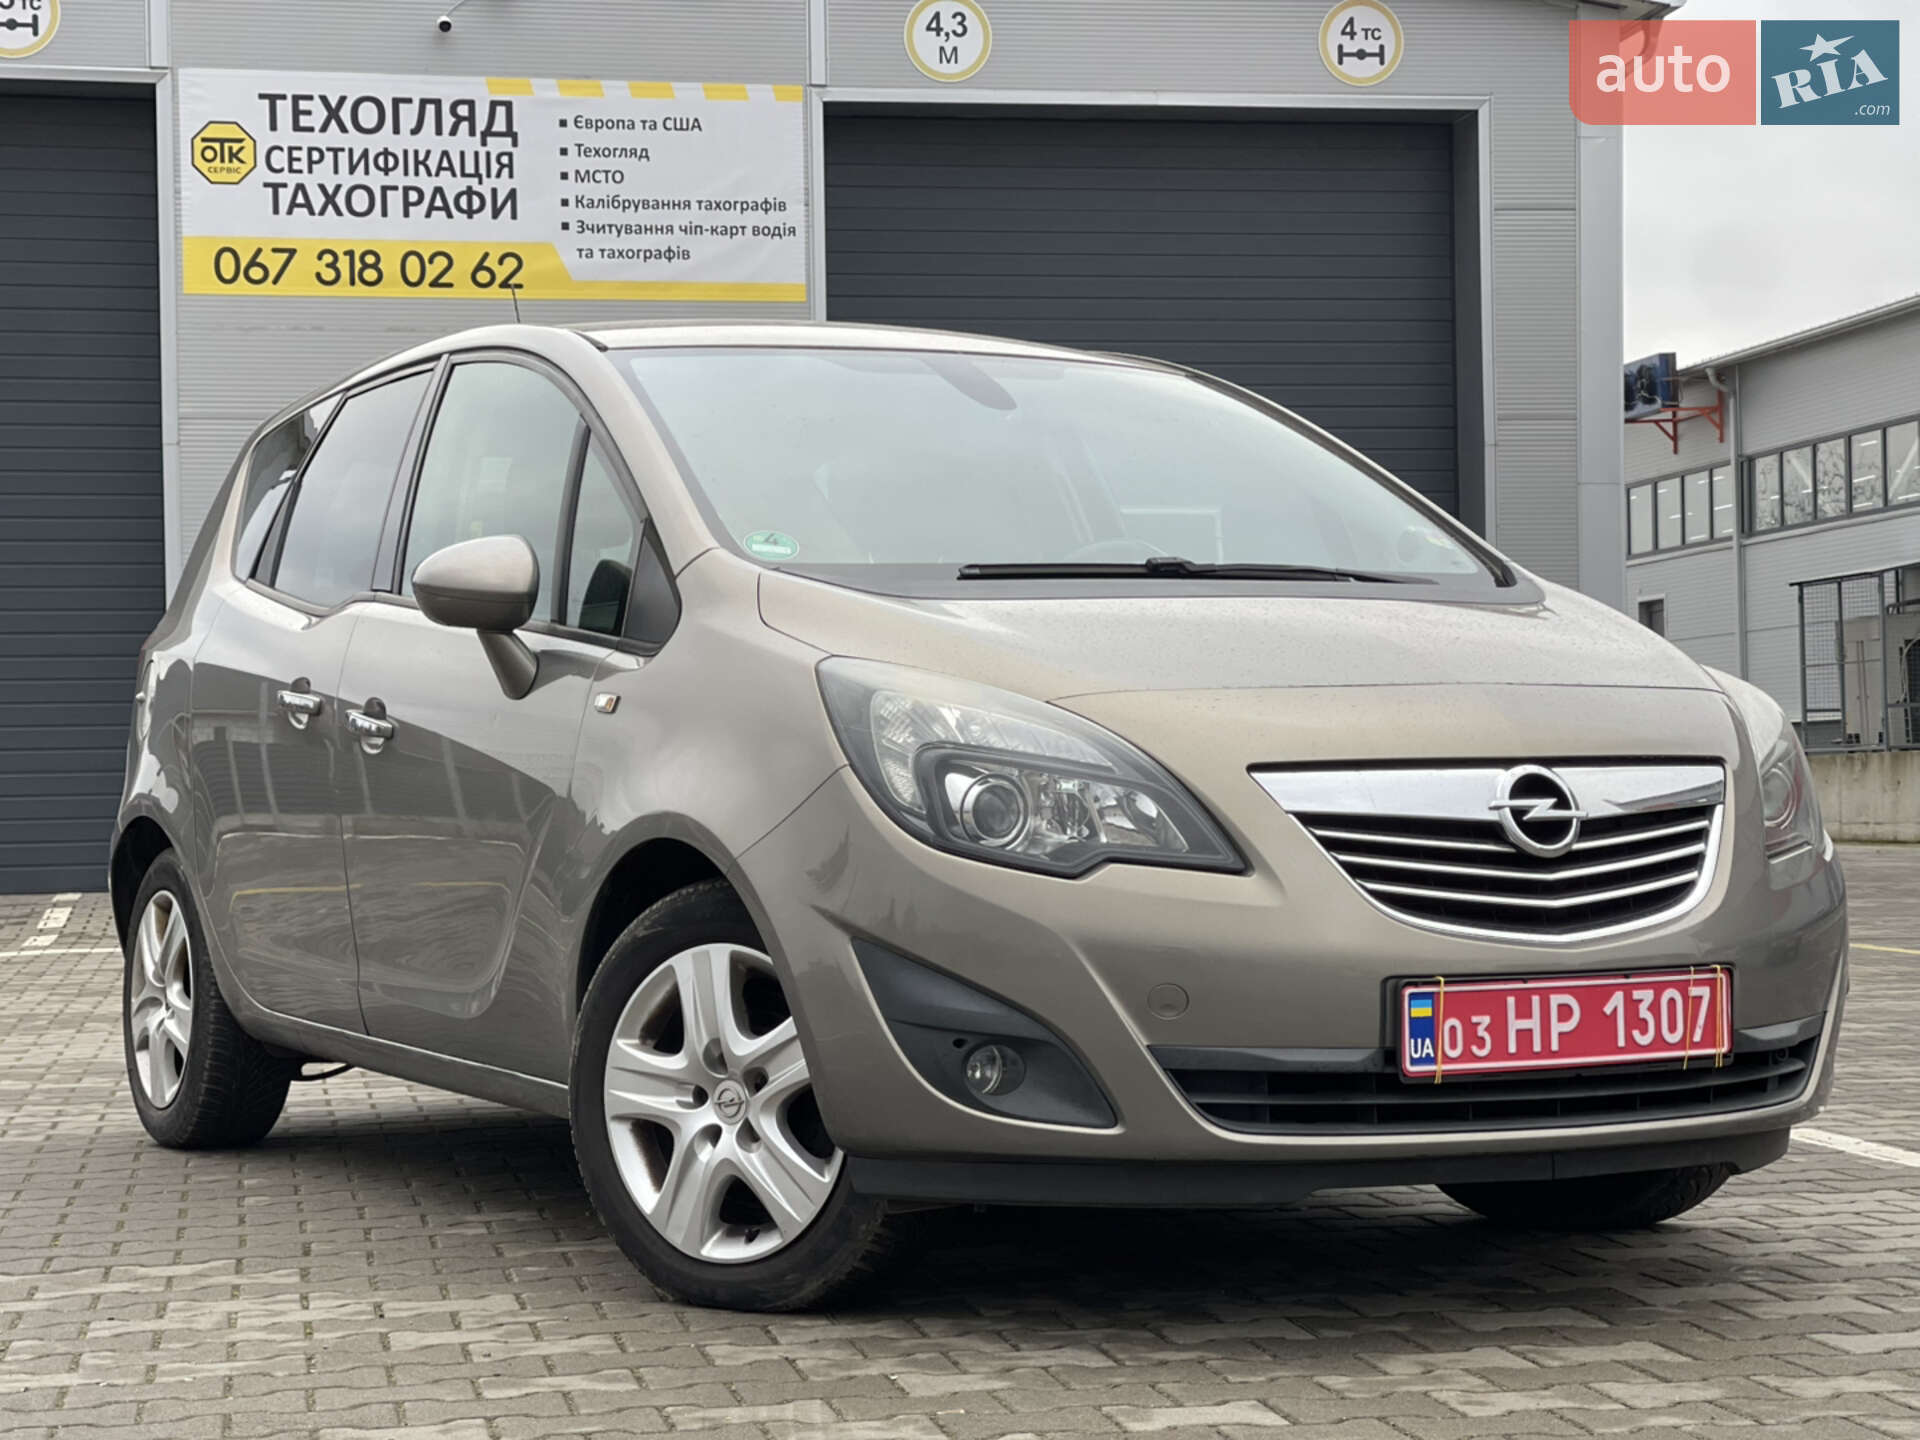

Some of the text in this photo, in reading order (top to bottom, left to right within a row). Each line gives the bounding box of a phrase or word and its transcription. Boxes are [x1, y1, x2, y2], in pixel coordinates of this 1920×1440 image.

[925, 10, 968, 42] 4,3
[1340, 16, 1357, 40] 4
[258, 93, 518, 148] ТЕХОГЛЯД
[573, 114, 703, 132] Європа та США
[200, 137, 246, 164] ОТК
[574, 143, 650, 162] Техогляд
[208, 166, 241, 174] СЕРВІС
[264, 145, 514, 185] СЕРТИФІКАЦІЯ
[574, 169, 625, 185] МСТО
[262, 181, 518, 220] ТАХОГРАФИ
[575, 194, 787, 215] Калібрування тахографів
[576, 219, 797, 240] Зчитування чіп-карт водія
[576, 245, 691, 263] та тахографів
[214, 246, 524, 289] 067 318 02 62
[1443, 1015, 1491, 1058] 03
[1602, 986, 1711, 1048] 1307
[1410, 1038, 1434, 1058] UA
